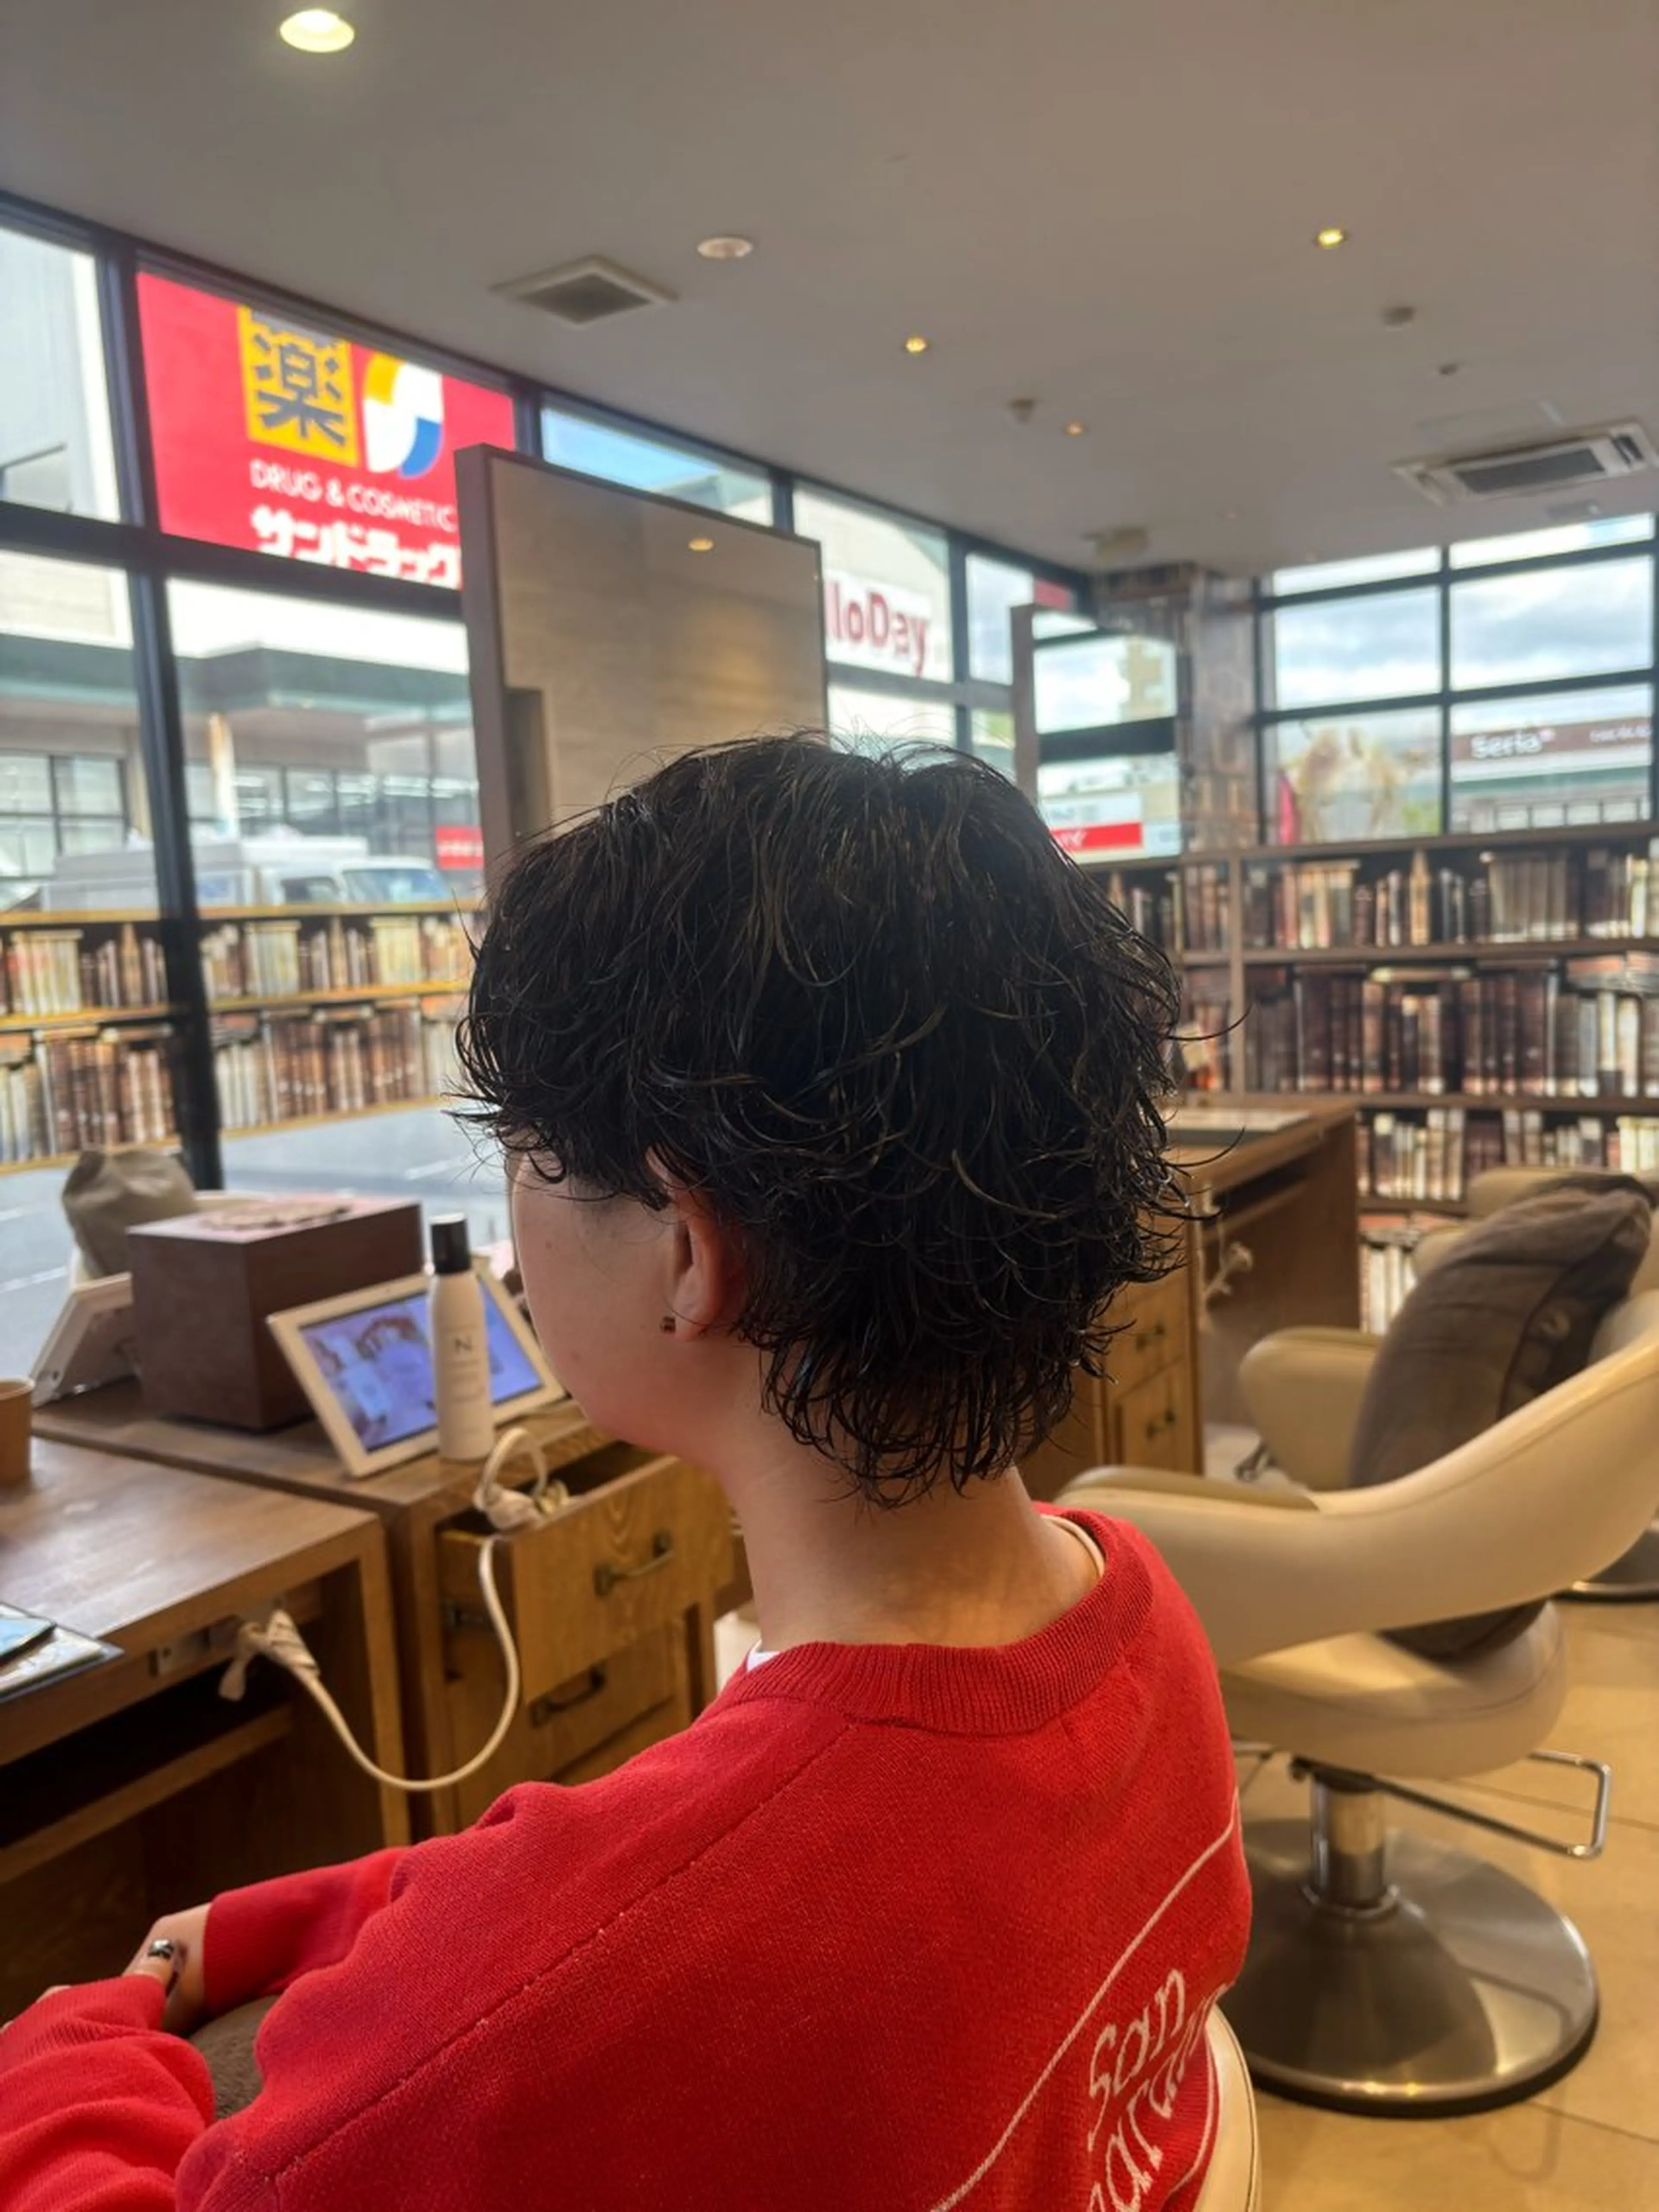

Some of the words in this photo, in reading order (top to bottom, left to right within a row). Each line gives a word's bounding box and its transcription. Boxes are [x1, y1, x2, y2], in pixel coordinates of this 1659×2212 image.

[250, 459, 322, 502] DRUG
[325, 477, 345, 508] &
[347, 484, 458, 533] COSMETIC
